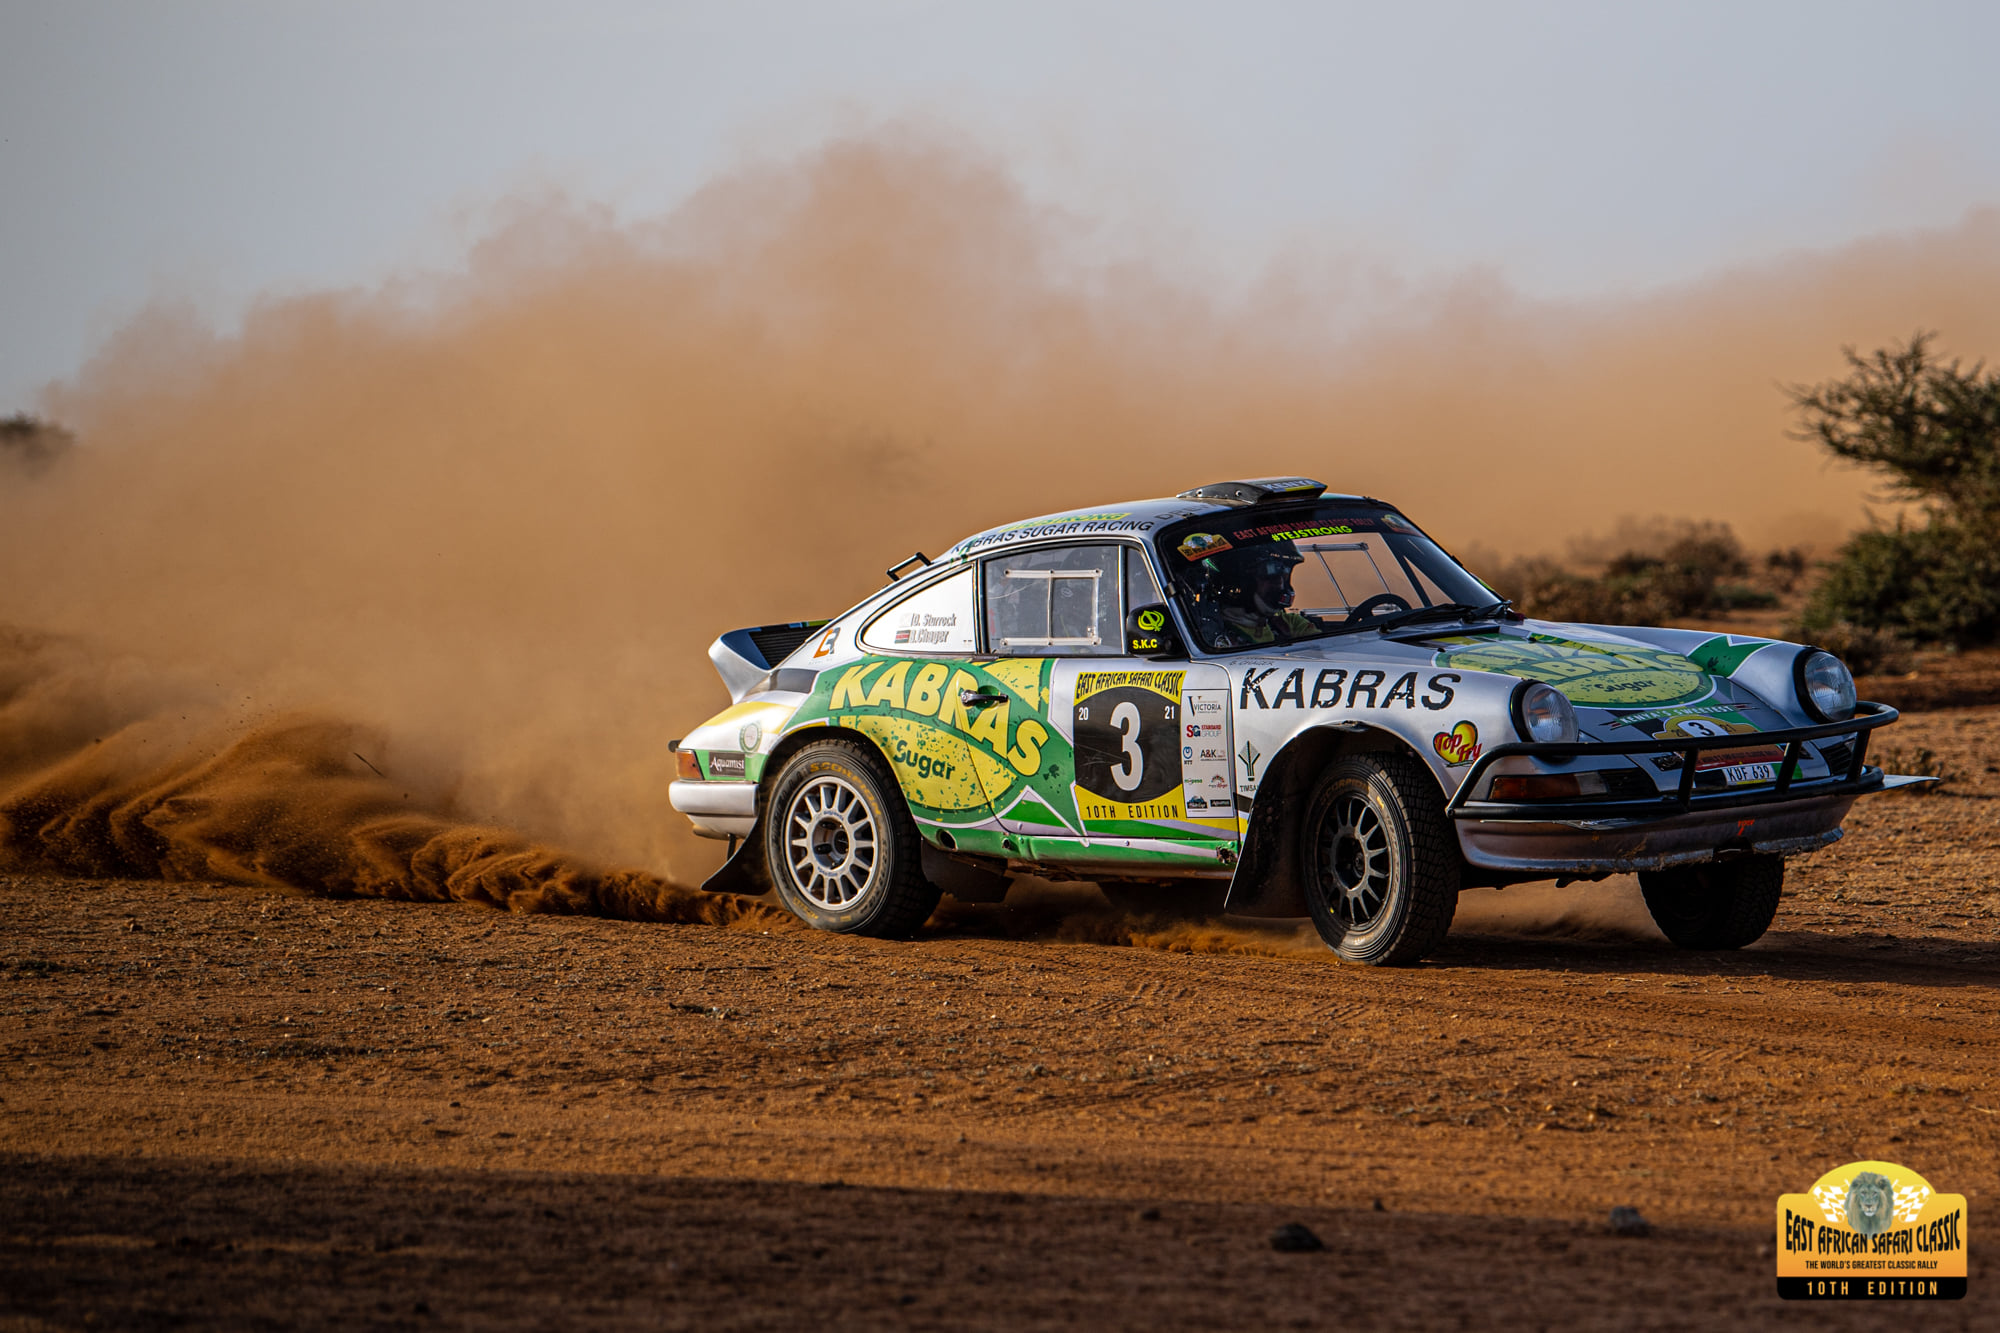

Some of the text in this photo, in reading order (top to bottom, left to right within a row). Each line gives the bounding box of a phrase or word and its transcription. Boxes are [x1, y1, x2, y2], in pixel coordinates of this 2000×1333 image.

[1019, 521, 1080, 539] SUGAR
[1082, 520, 1155, 533] RACING
[1233, 529, 1258, 540] EAST
[1271, 525, 1353, 541] #TEJSTRONG
[1132, 638, 1158, 650] S.K.C
[1075, 671, 1183, 699] EAST AFRICAN SAFARI CLASSIC
[1240, 667, 1462, 711] KABRAS
[1594, 679, 1657, 693] Sugar
[1078, 706, 1089, 721] 20
[1164, 705, 1176, 720] 21
[1193, 703, 1222, 711] VICTORIA
[1619, 705, 1735, 725] KENYA'S SWEETEST
[828, 660, 1049, 777] KABRAS
[1687, 721, 1716, 737] 3
[1110, 701, 1144, 792] 3
[1434, 733, 1463, 754] Top
[893, 739, 957, 781] Sugar
[1200, 749, 1217, 758] A&K
[1456, 742, 1483, 763] Fry
[709, 756, 745, 772] Aquamist
[1751, 765, 1770, 779] 639
[810, 761, 881, 815] SCORPION
[1086, 805, 1117, 819] 10TH
[1128, 804, 1179, 819] EDITION
